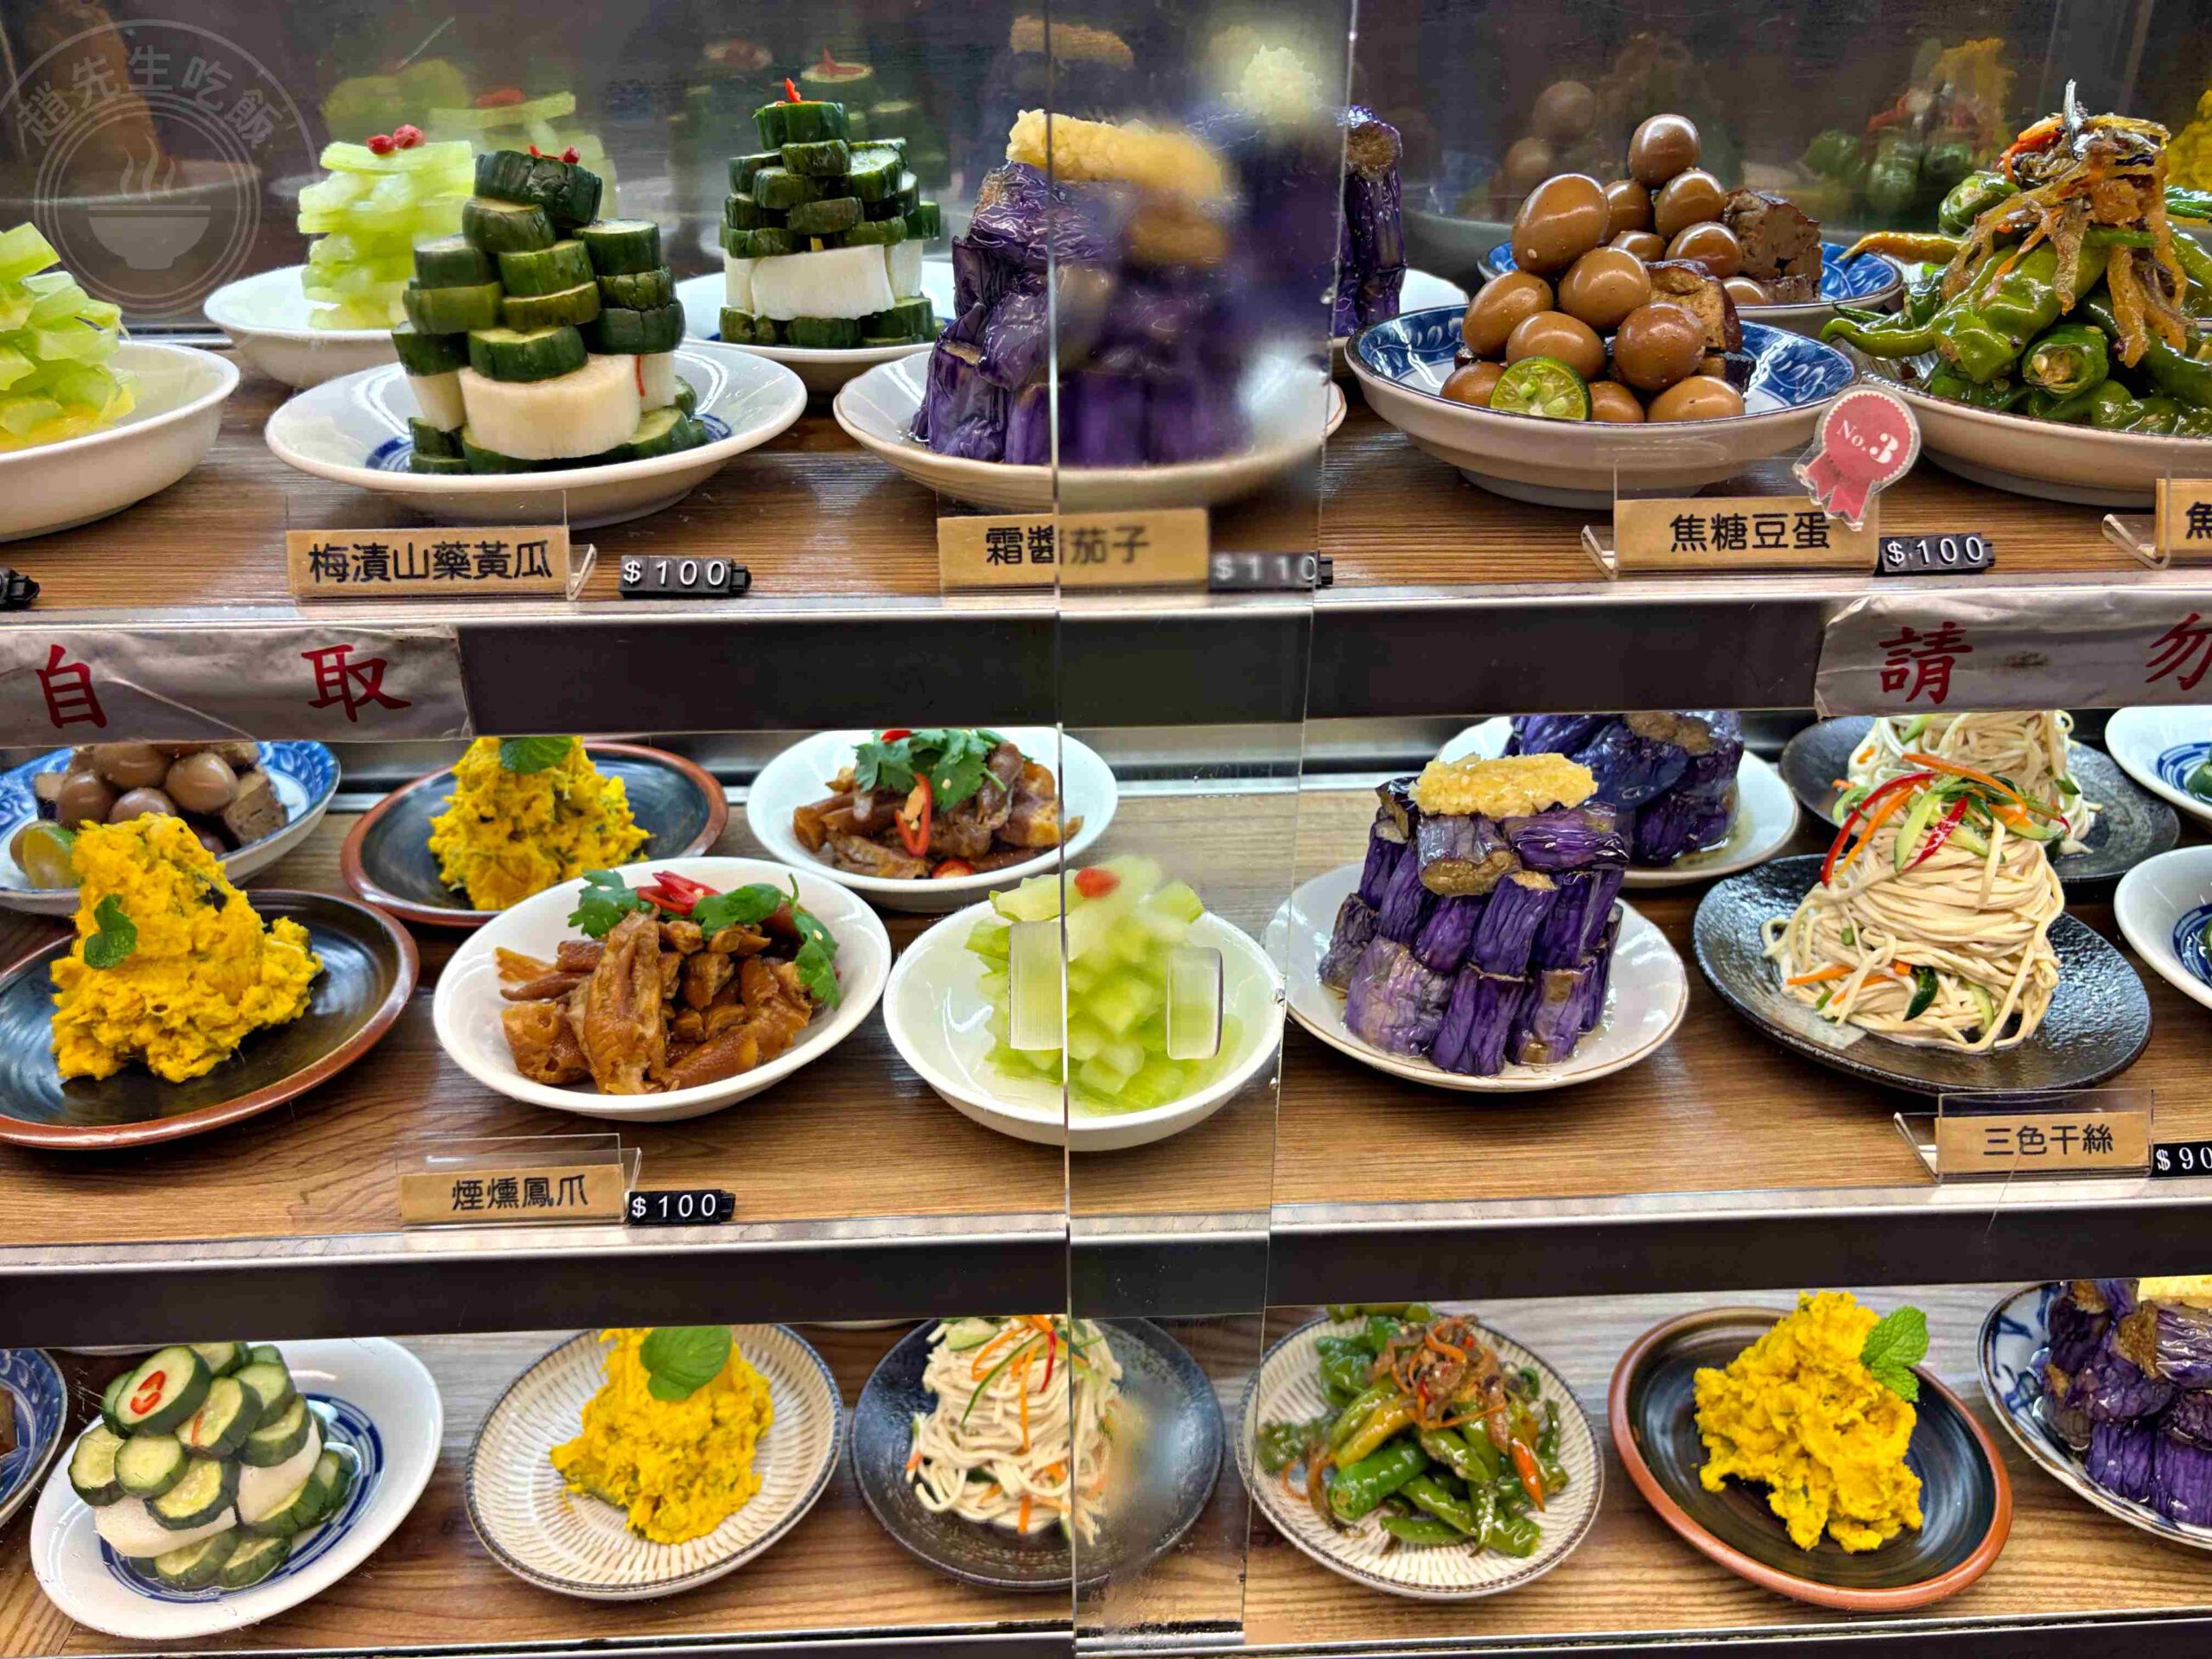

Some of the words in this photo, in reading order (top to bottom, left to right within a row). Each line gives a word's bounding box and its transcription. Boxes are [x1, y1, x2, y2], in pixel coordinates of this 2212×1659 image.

[986, 525, 1150, 566] 霜醬茄子
[1669, 512, 1832, 554] 焦糖豆蛋
[308, 540, 553, 584] 梅漬山藥黃瓜
[1885, 535, 1985, 566] $100
[623, 559, 726, 587] $100
[1215, 555, 1317, 582] $110
[1982, 1123, 2113, 1156] 三色干絲
[2156, 1147, 2212, 1171] $90
[451, 1174, 589, 1211] 煙燻鳳爪
[632, 1193, 716, 1218] $100
